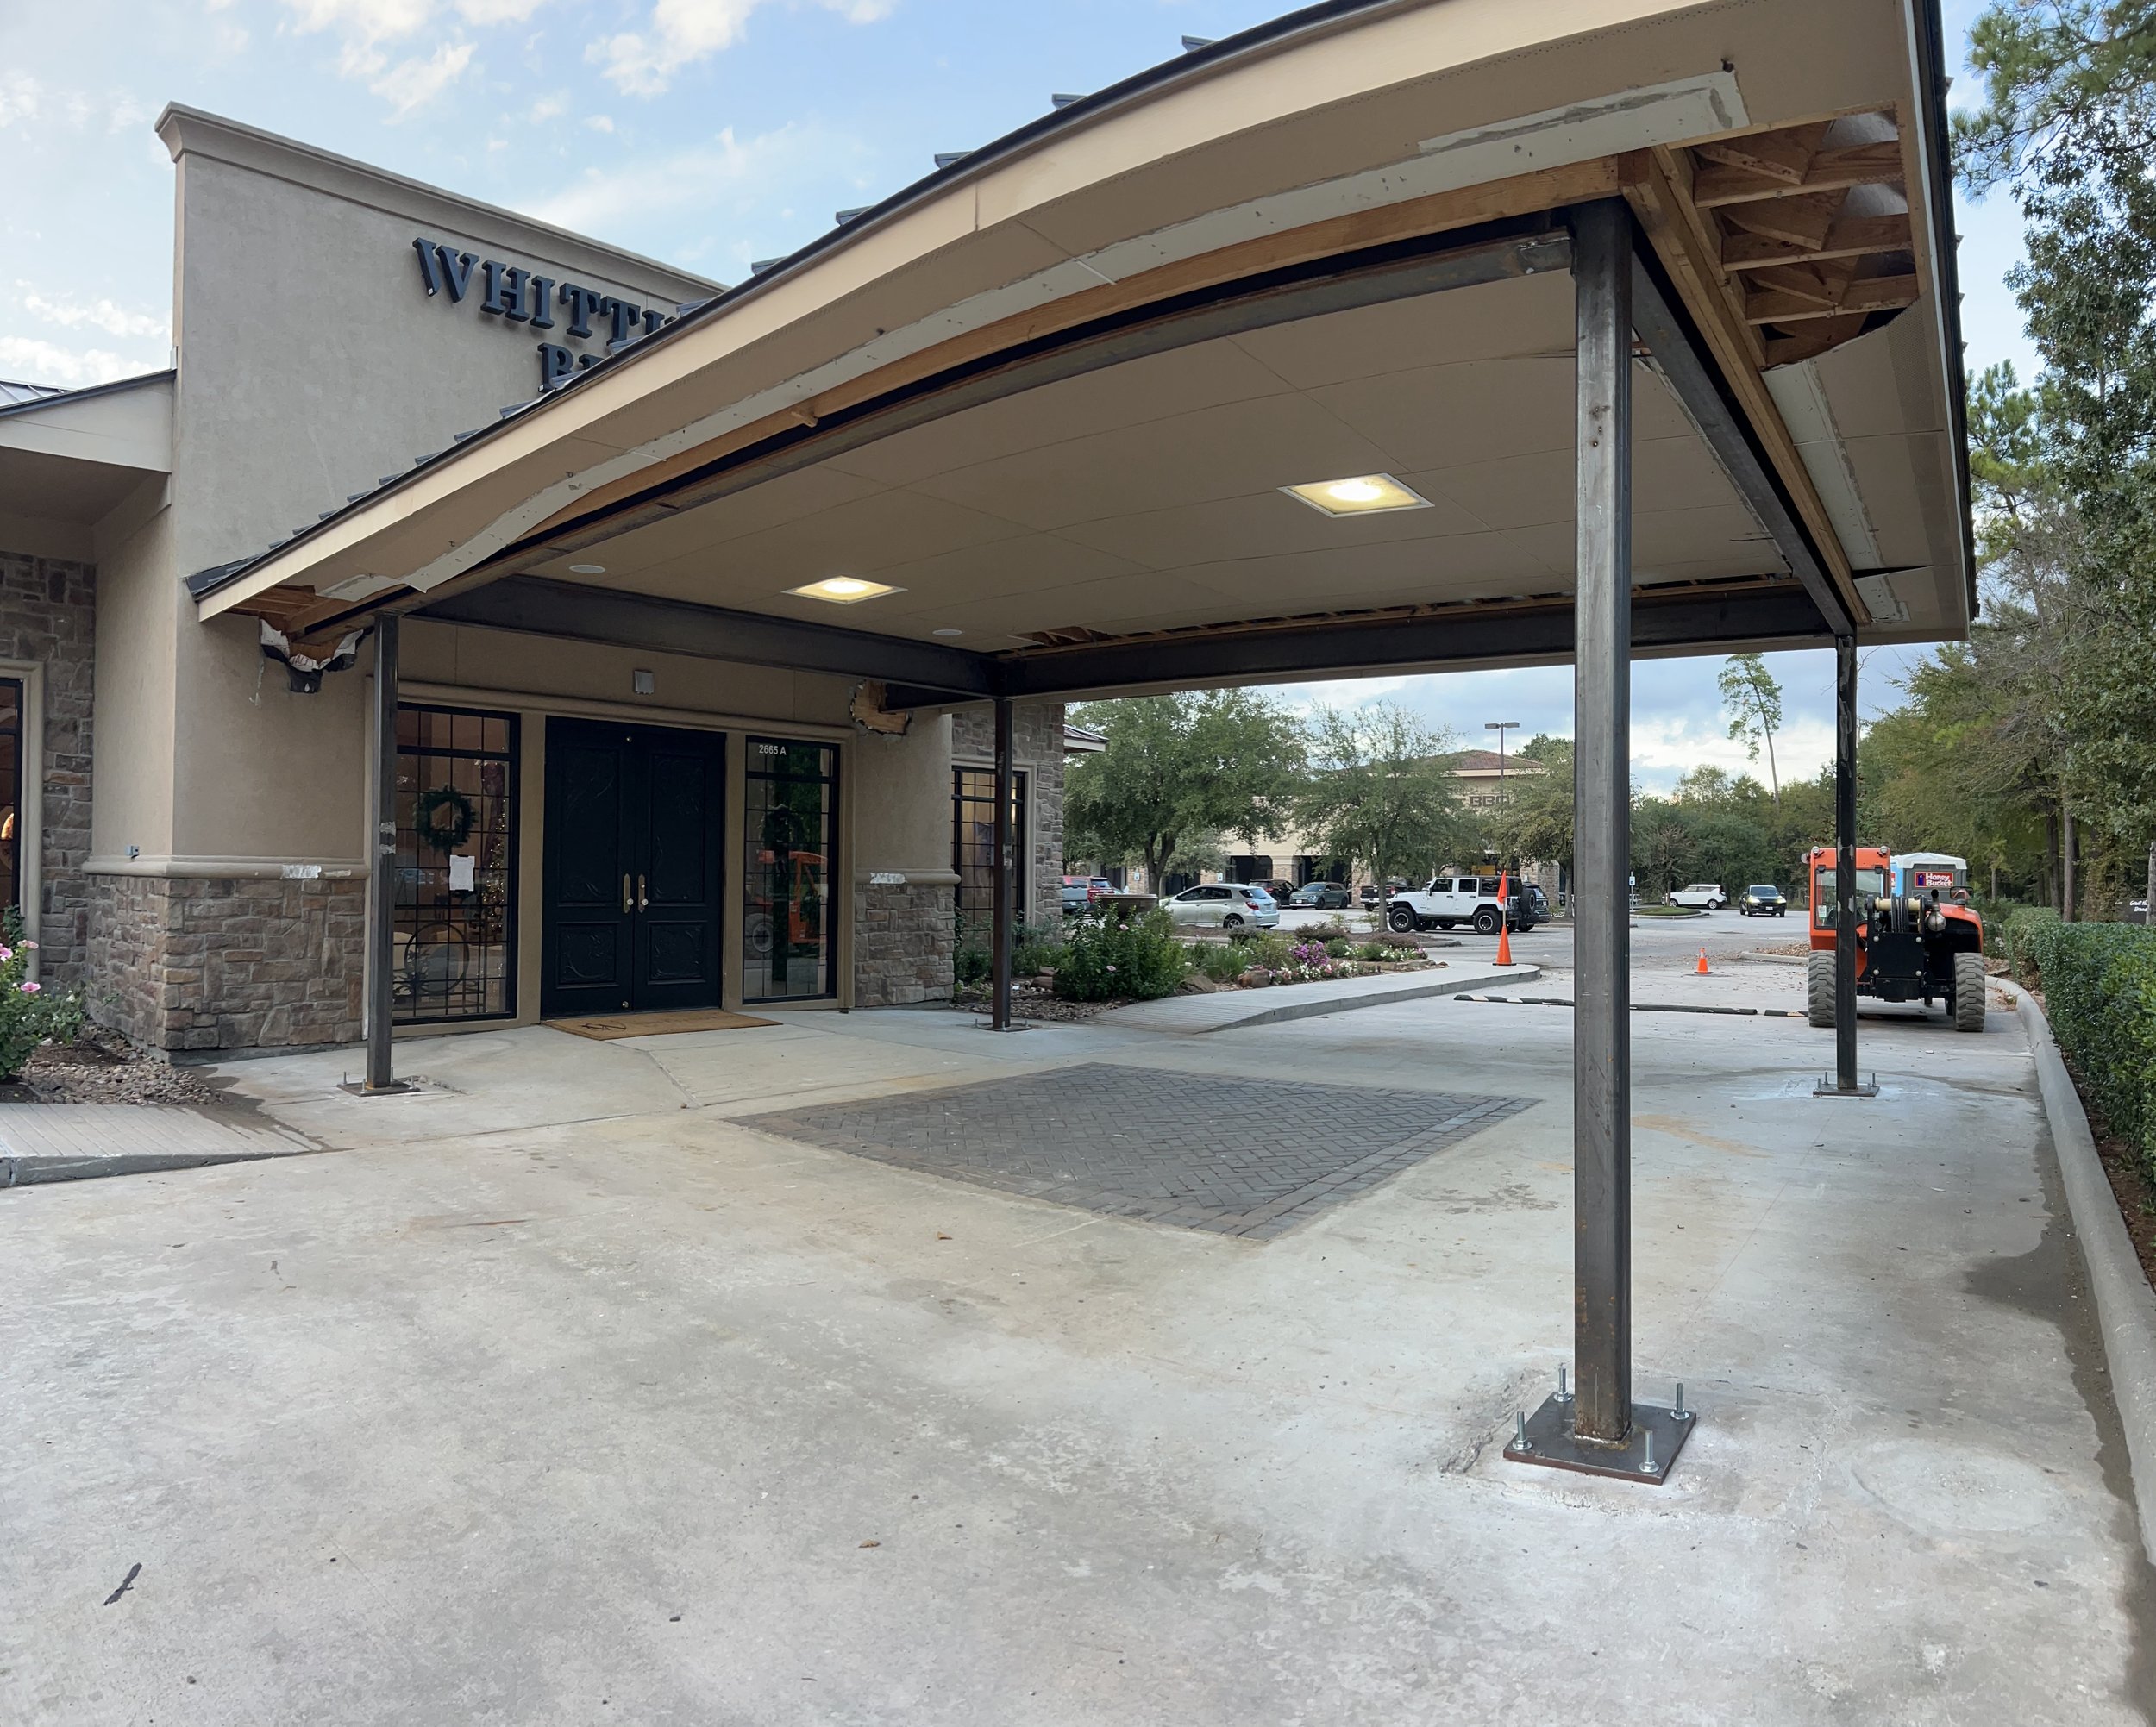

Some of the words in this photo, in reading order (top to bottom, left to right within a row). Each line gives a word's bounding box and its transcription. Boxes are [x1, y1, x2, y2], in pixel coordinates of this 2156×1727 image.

[759, 744, 779, 755] 2665
[780, 746, 787, 755] A
[1926, 873, 1950, 882] Honey
